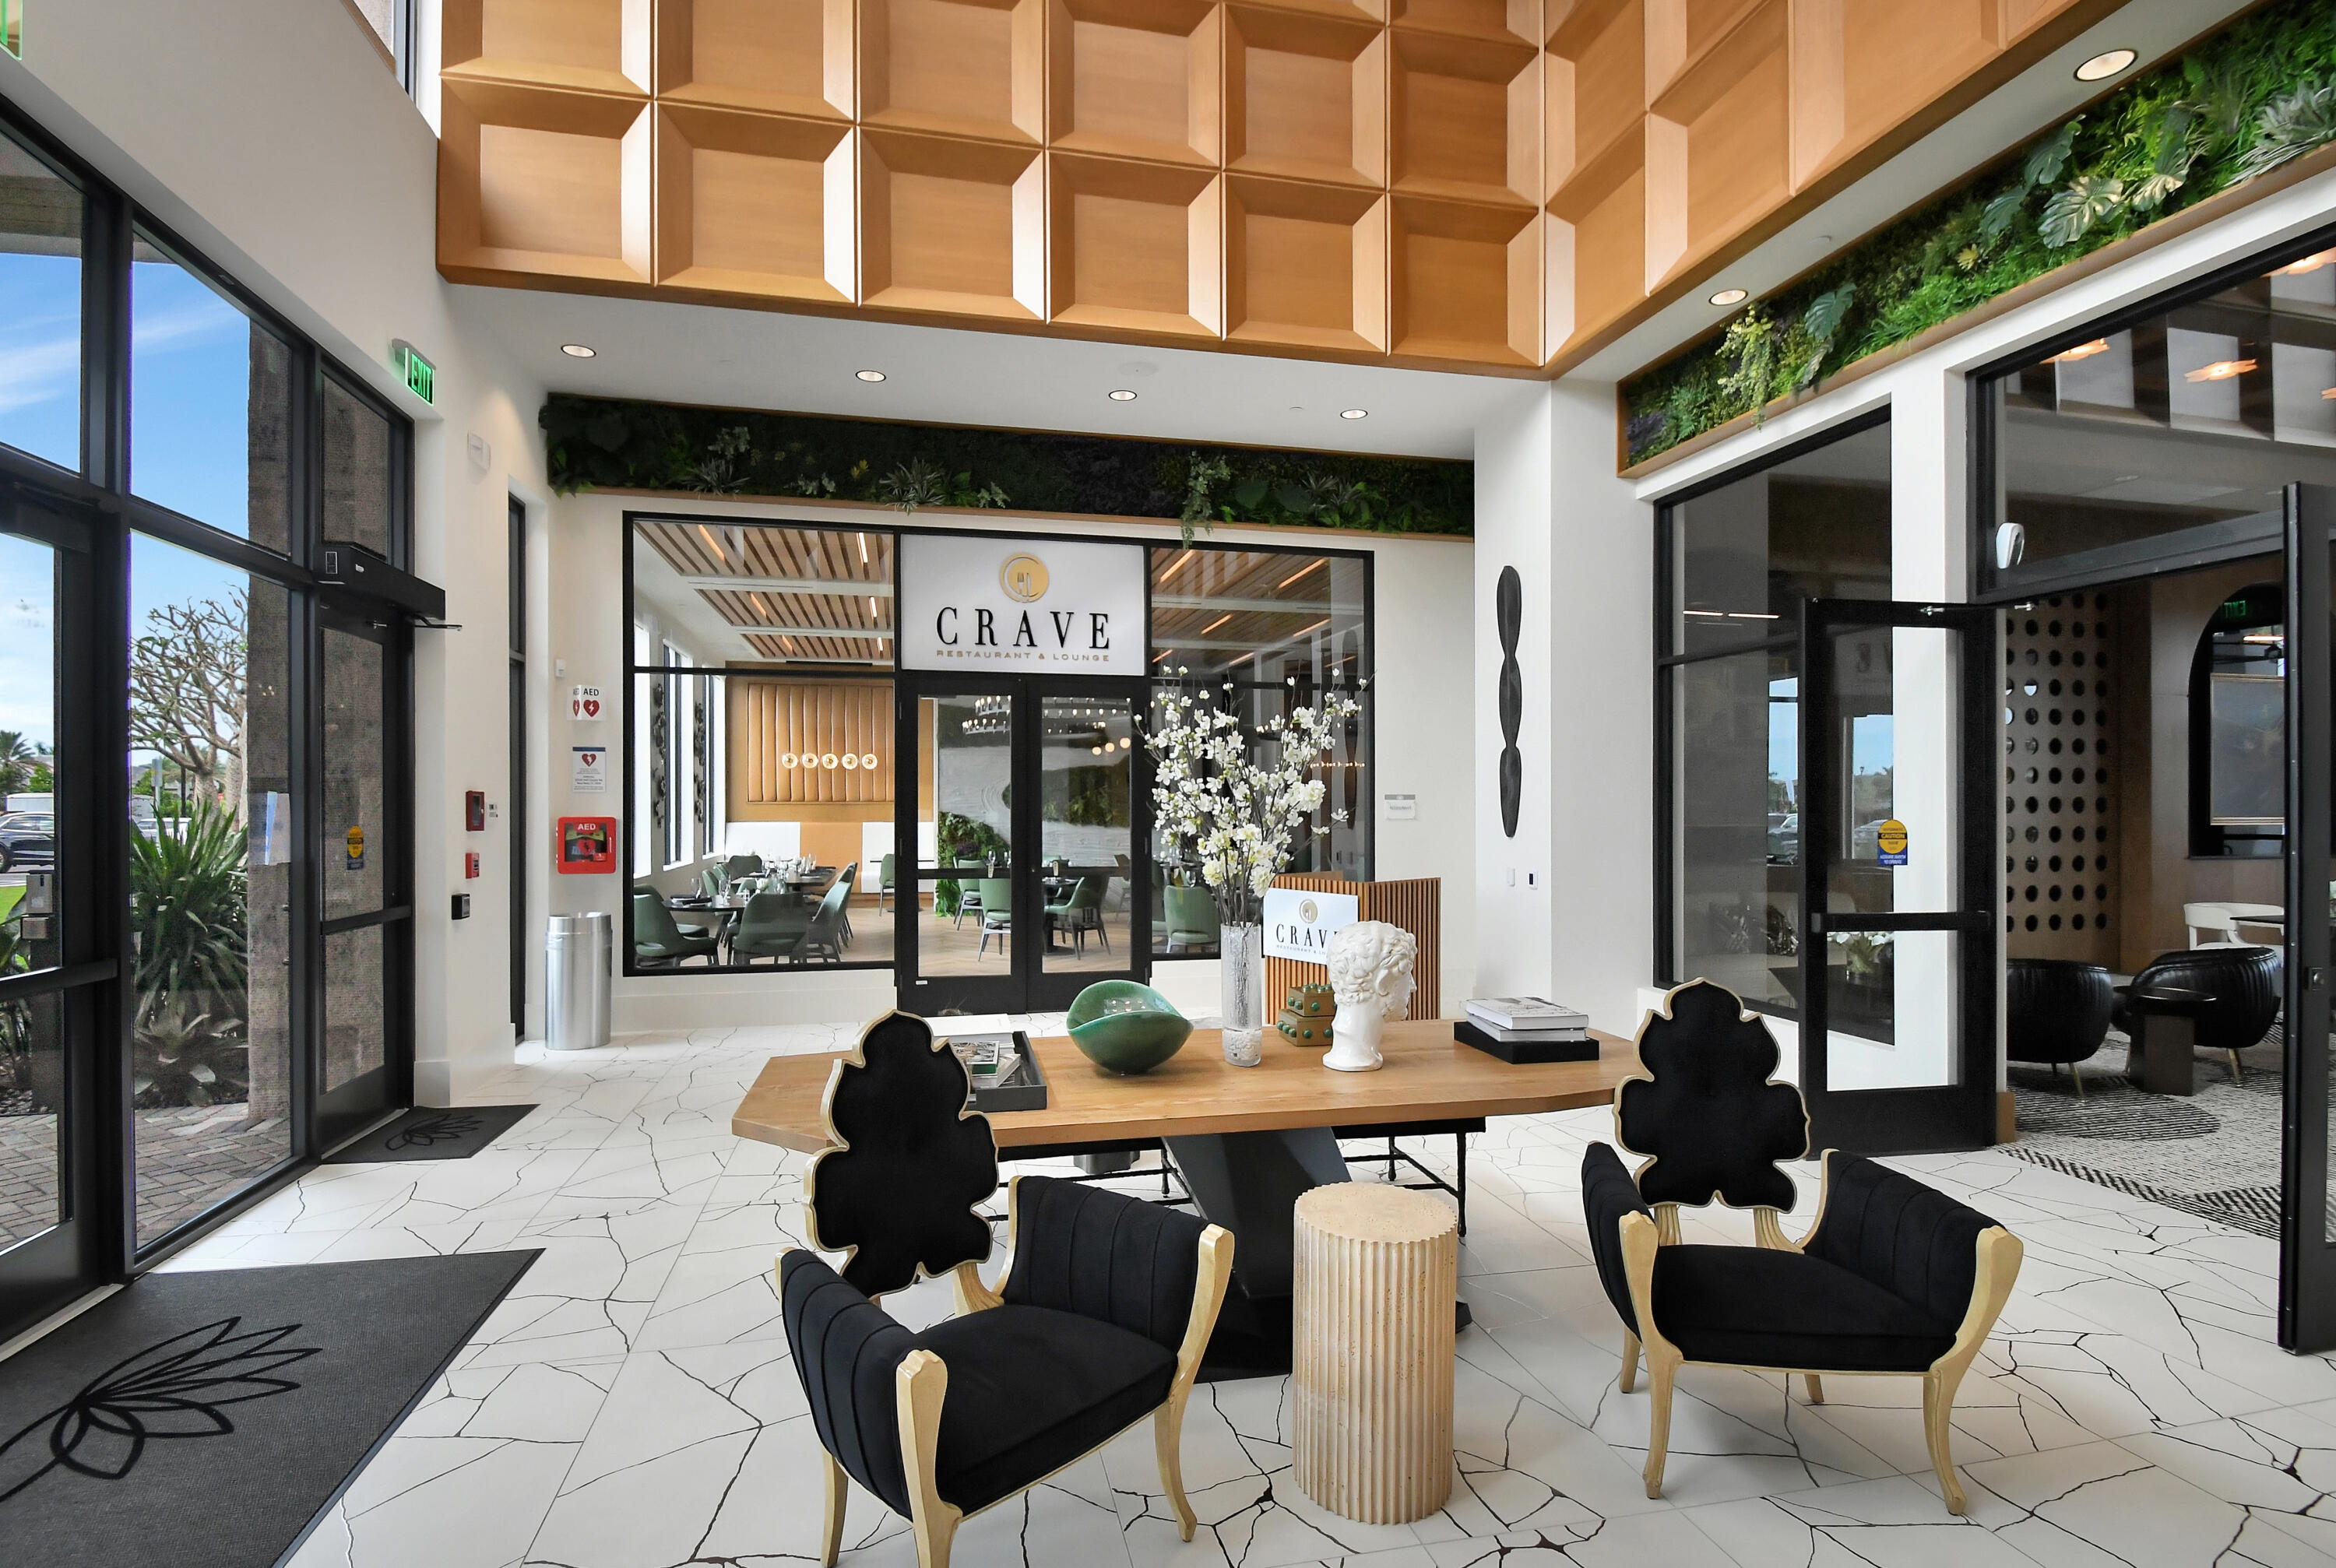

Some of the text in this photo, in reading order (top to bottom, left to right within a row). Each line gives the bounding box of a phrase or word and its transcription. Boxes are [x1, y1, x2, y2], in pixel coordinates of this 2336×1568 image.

[411, 353, 432, 402] EXIT
[936, 606, 1110, 650] CRAVE
[936, 649, 1031, 659] RESTAURANT
[1053, 652, 1110, 662] LOUNGE
[582, 687, 600, 697] AED
[1275, 923, 1338, 949] CRAV
